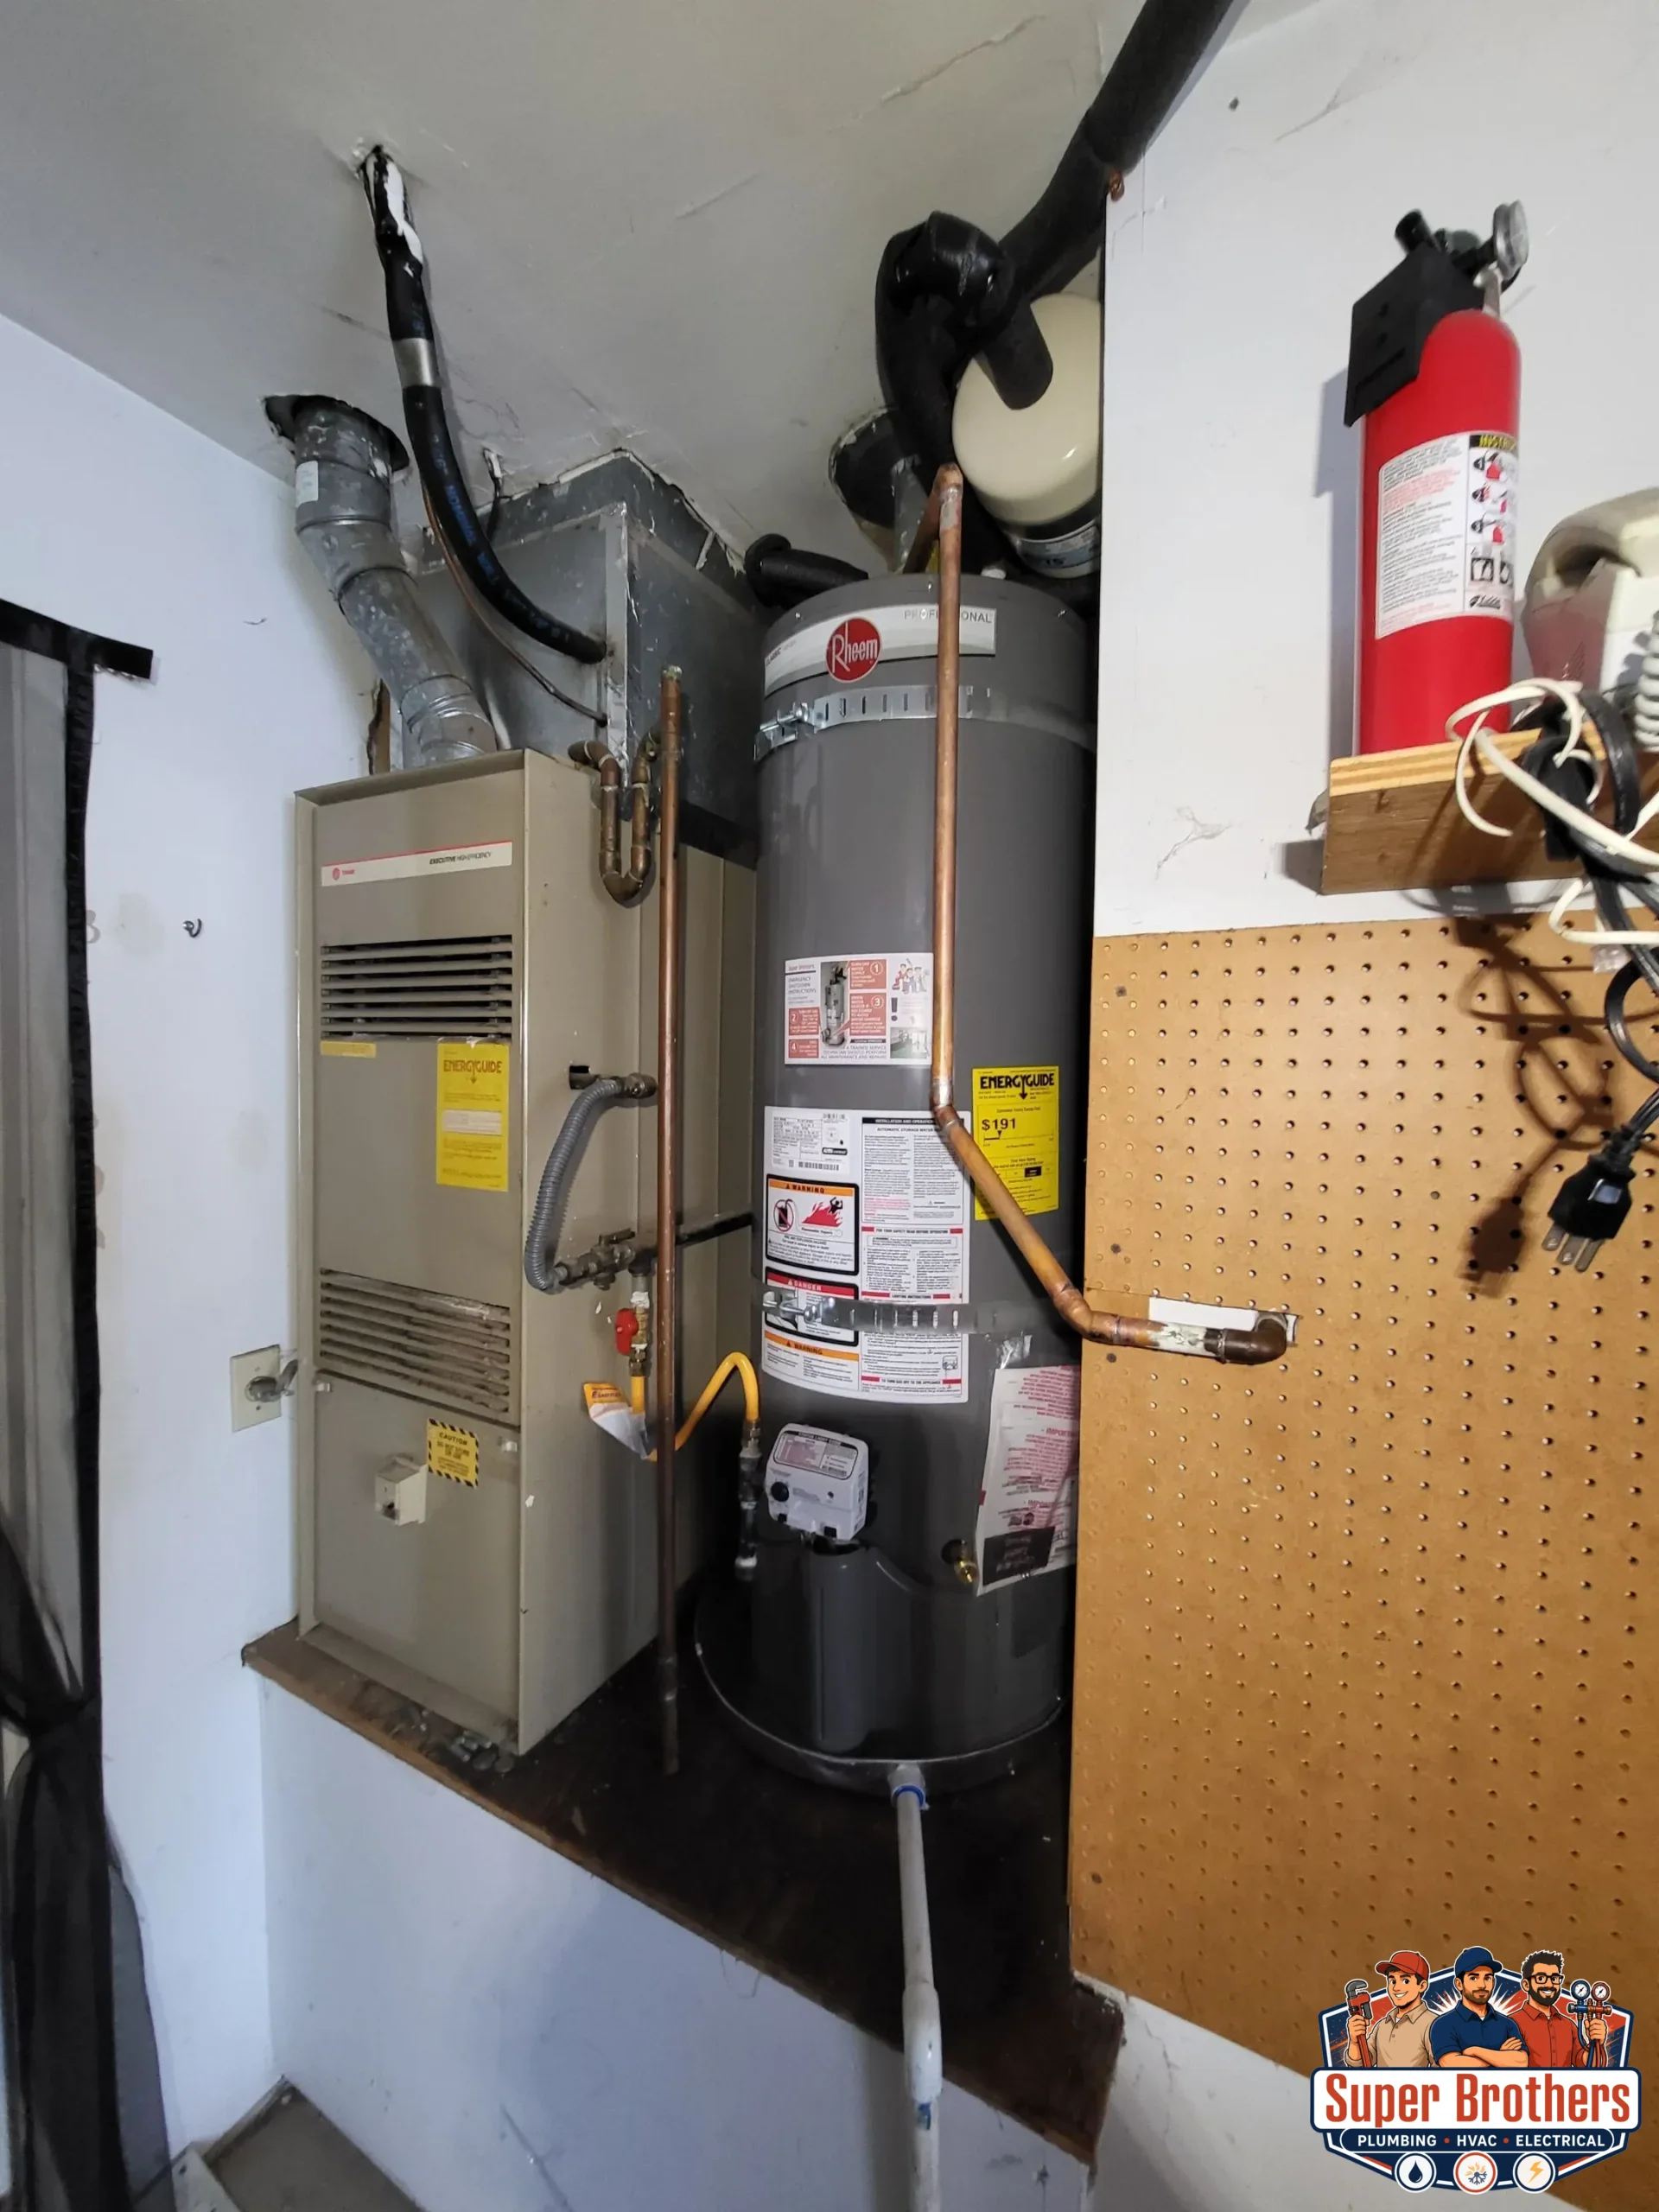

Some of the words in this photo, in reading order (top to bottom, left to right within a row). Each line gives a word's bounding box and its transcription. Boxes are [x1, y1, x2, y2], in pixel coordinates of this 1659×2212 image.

[904, 609, 993, 624] PROFONAL
[832, 620, 878, 674] Rheem
[980, 1073, 1055, 1090] ENERGYGUIDE
[982, 1117, 1016, 1131] $191
[794, 1280, 822, 1293] DANGER
[795, 1342, 823, 1356] WARNING
[439, 1432, 467, 1446] CAUTION
